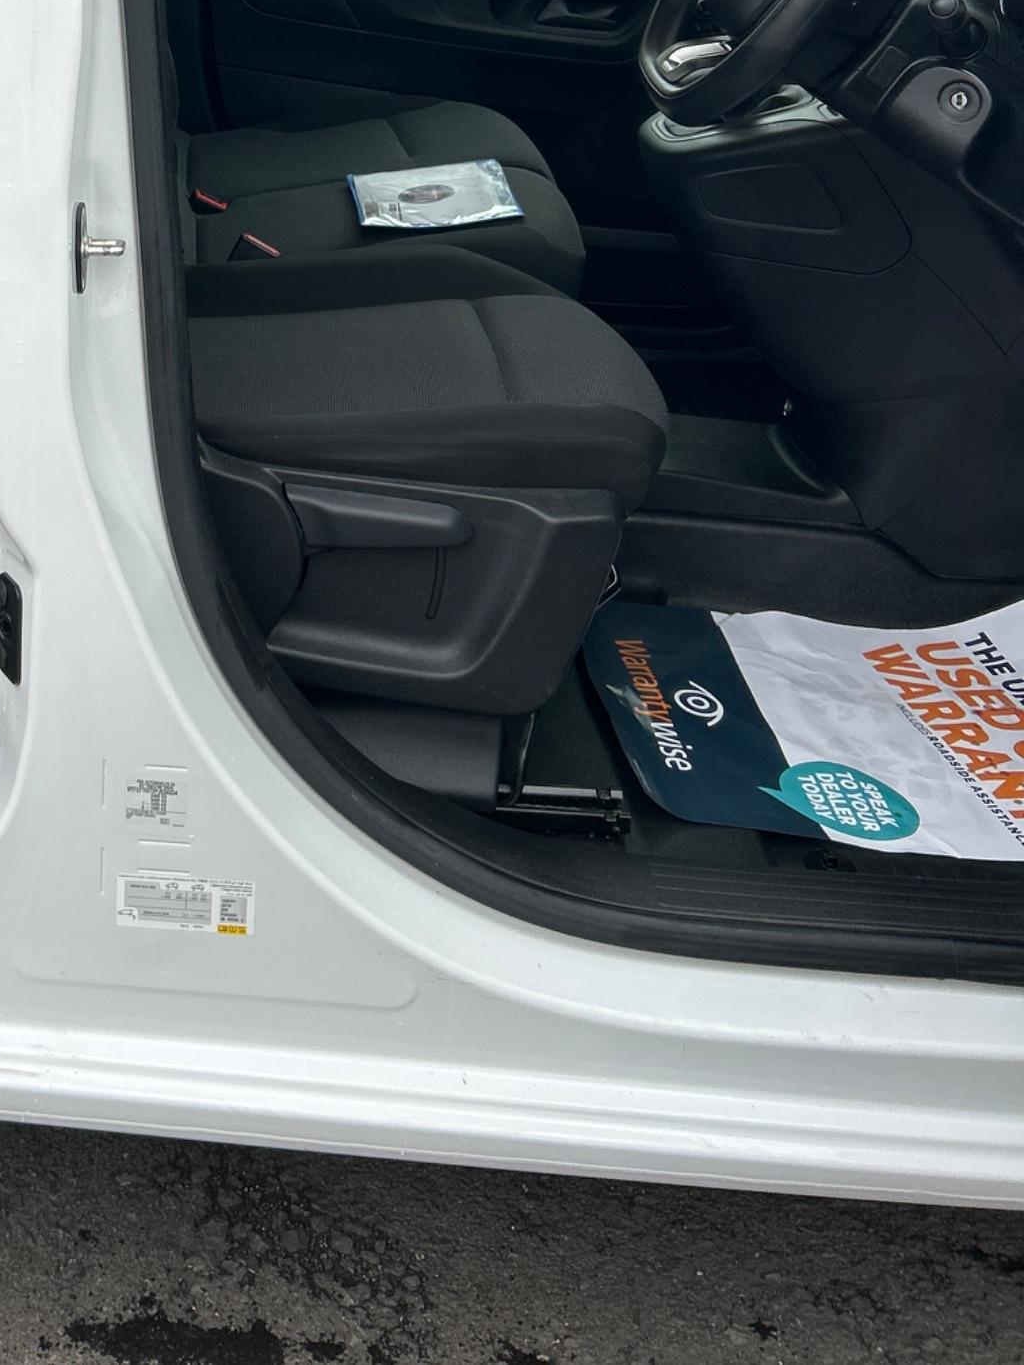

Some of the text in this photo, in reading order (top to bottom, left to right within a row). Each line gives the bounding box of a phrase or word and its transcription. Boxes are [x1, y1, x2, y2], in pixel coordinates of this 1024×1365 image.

[916, 641, 1024, 730] USED
[964, 632, 1024, 706] THE U
[797, 774, 836, 821] TODAY
[816, 772, 857, 826] DEALER
[836, 771, 881, 832] TO YOUR
[859, 781, 899, 828] SPEAK
[927, 736, 976, 783] ROADSIDE
[970, 784, 1024, 847] ASSISTANC
